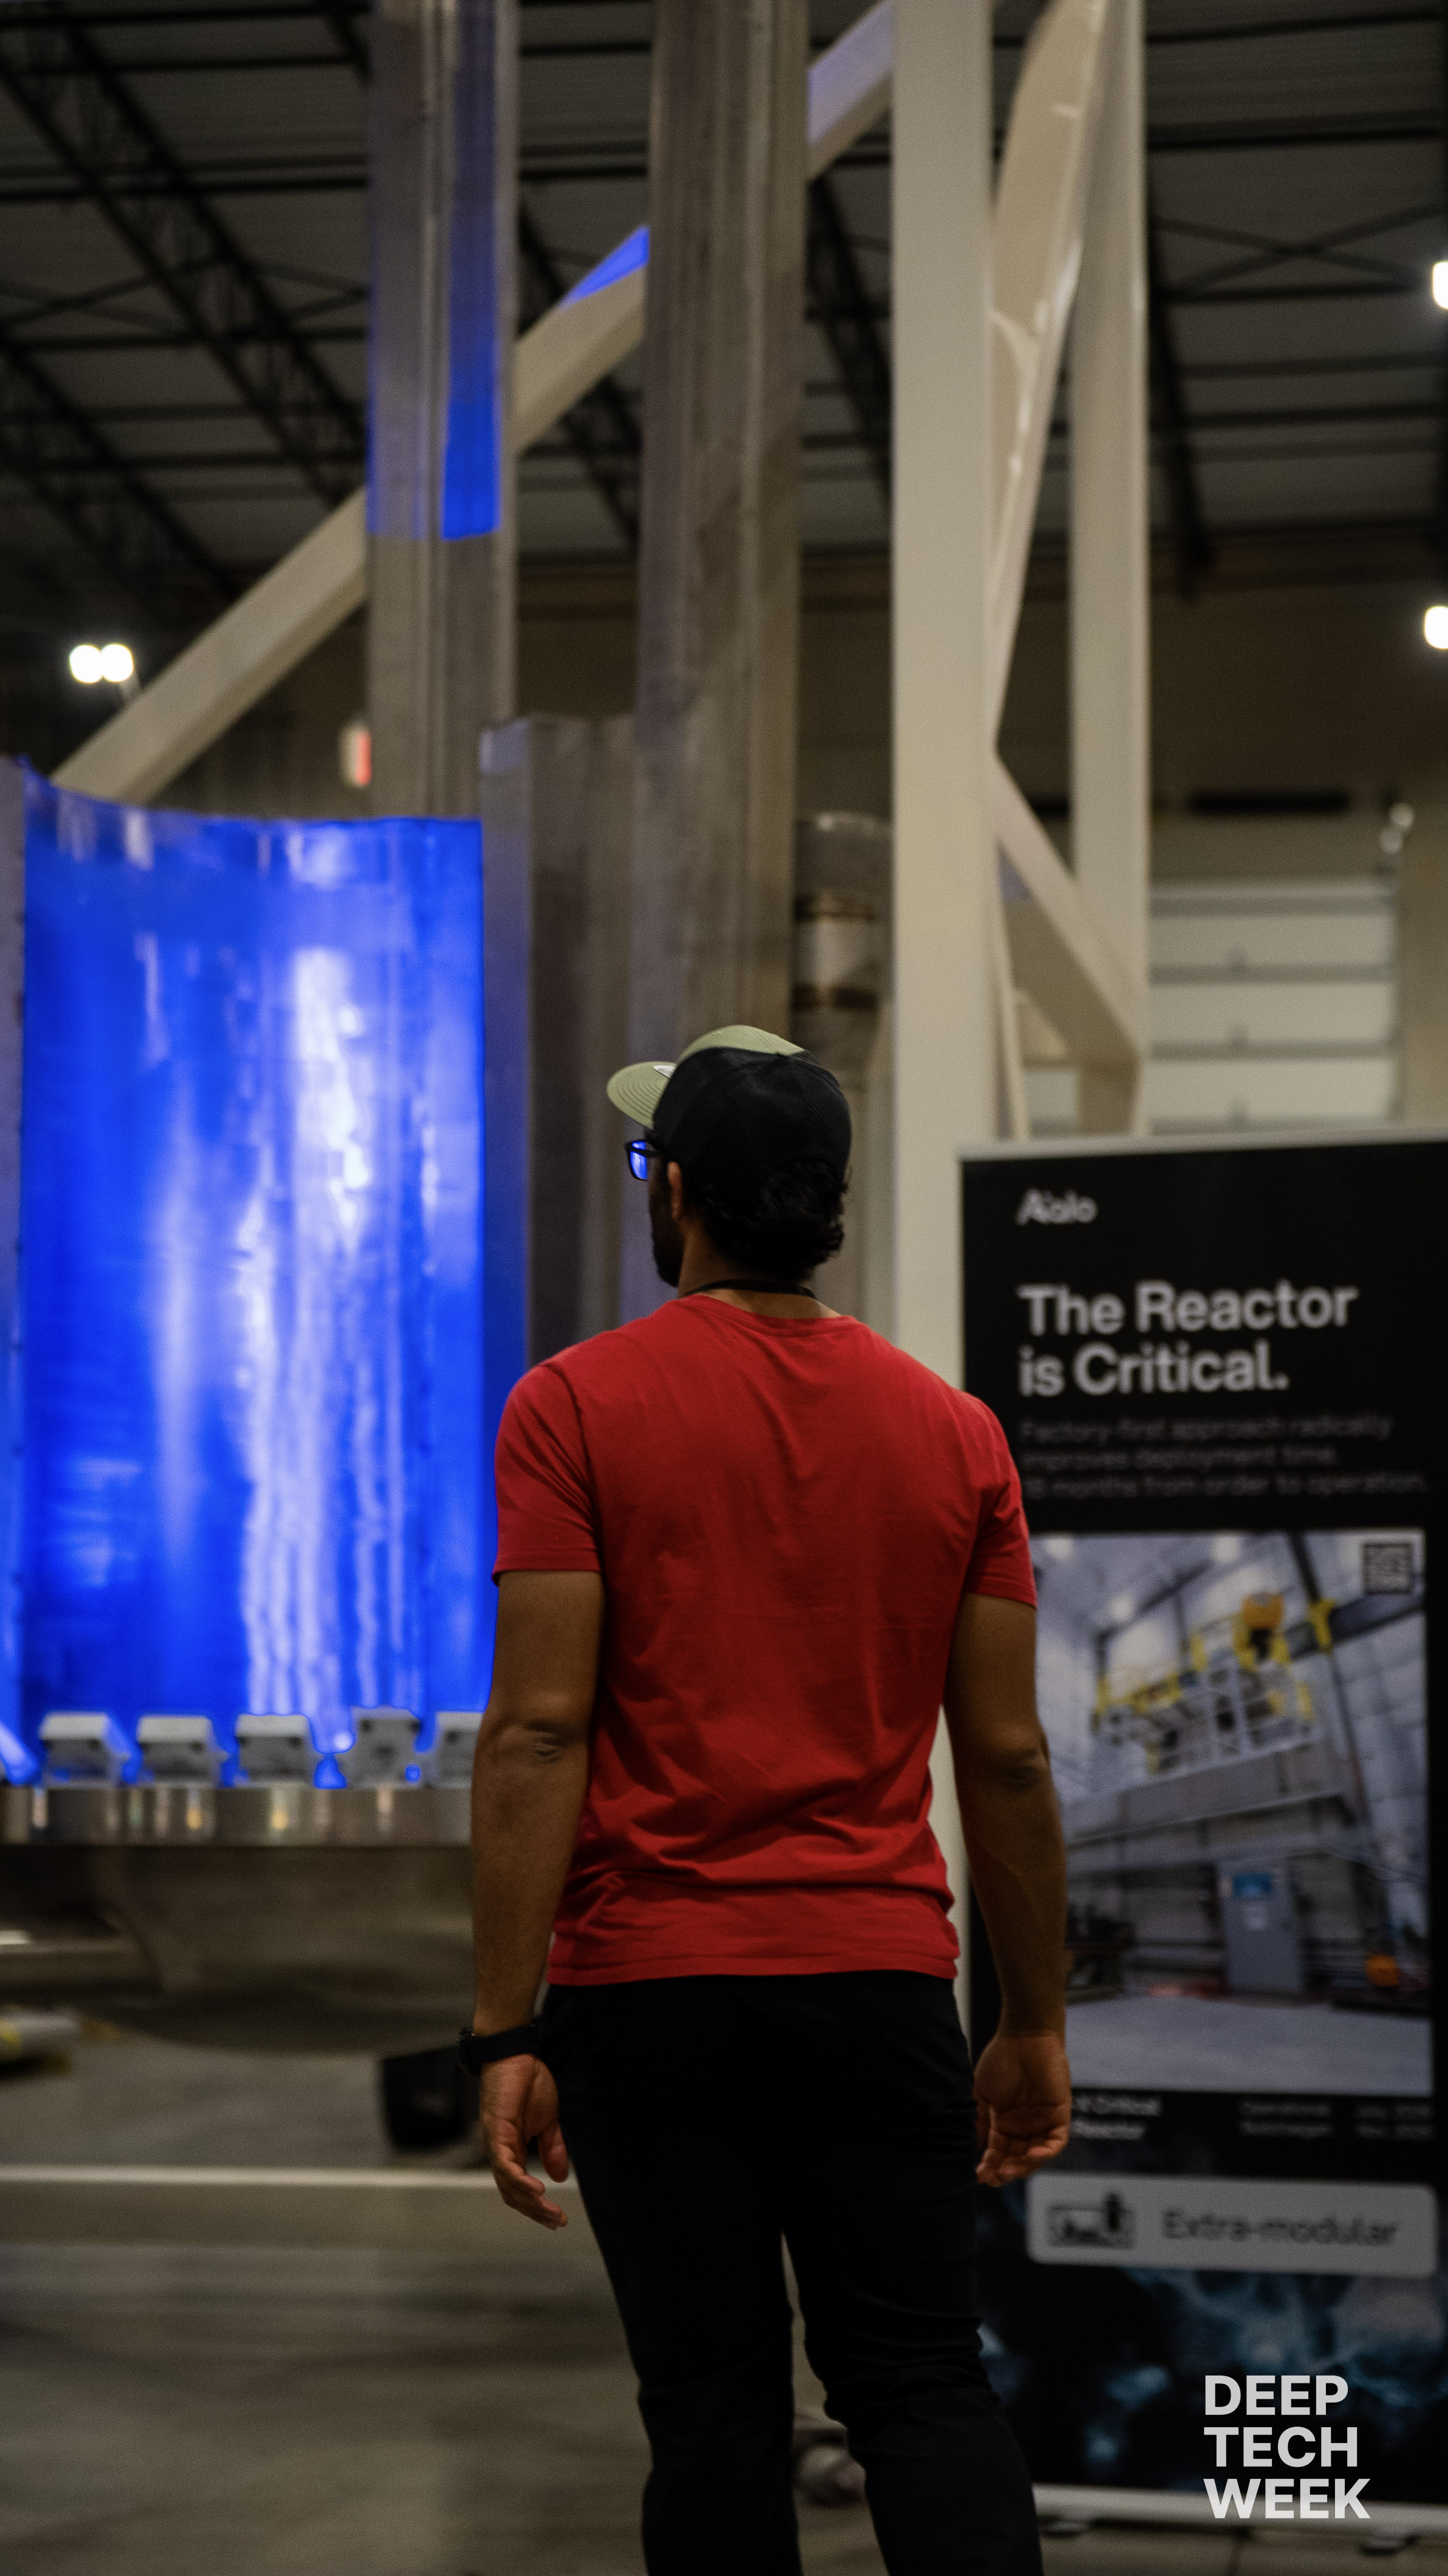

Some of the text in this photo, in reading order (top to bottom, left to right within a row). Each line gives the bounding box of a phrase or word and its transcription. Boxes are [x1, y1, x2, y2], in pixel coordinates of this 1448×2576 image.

[1019, 1281, 1358, 1335] The Reactor
[1020, 1340, 1288, 1396] is Critical.
[1163, 2209, 1397, 2246] Extra-modular
